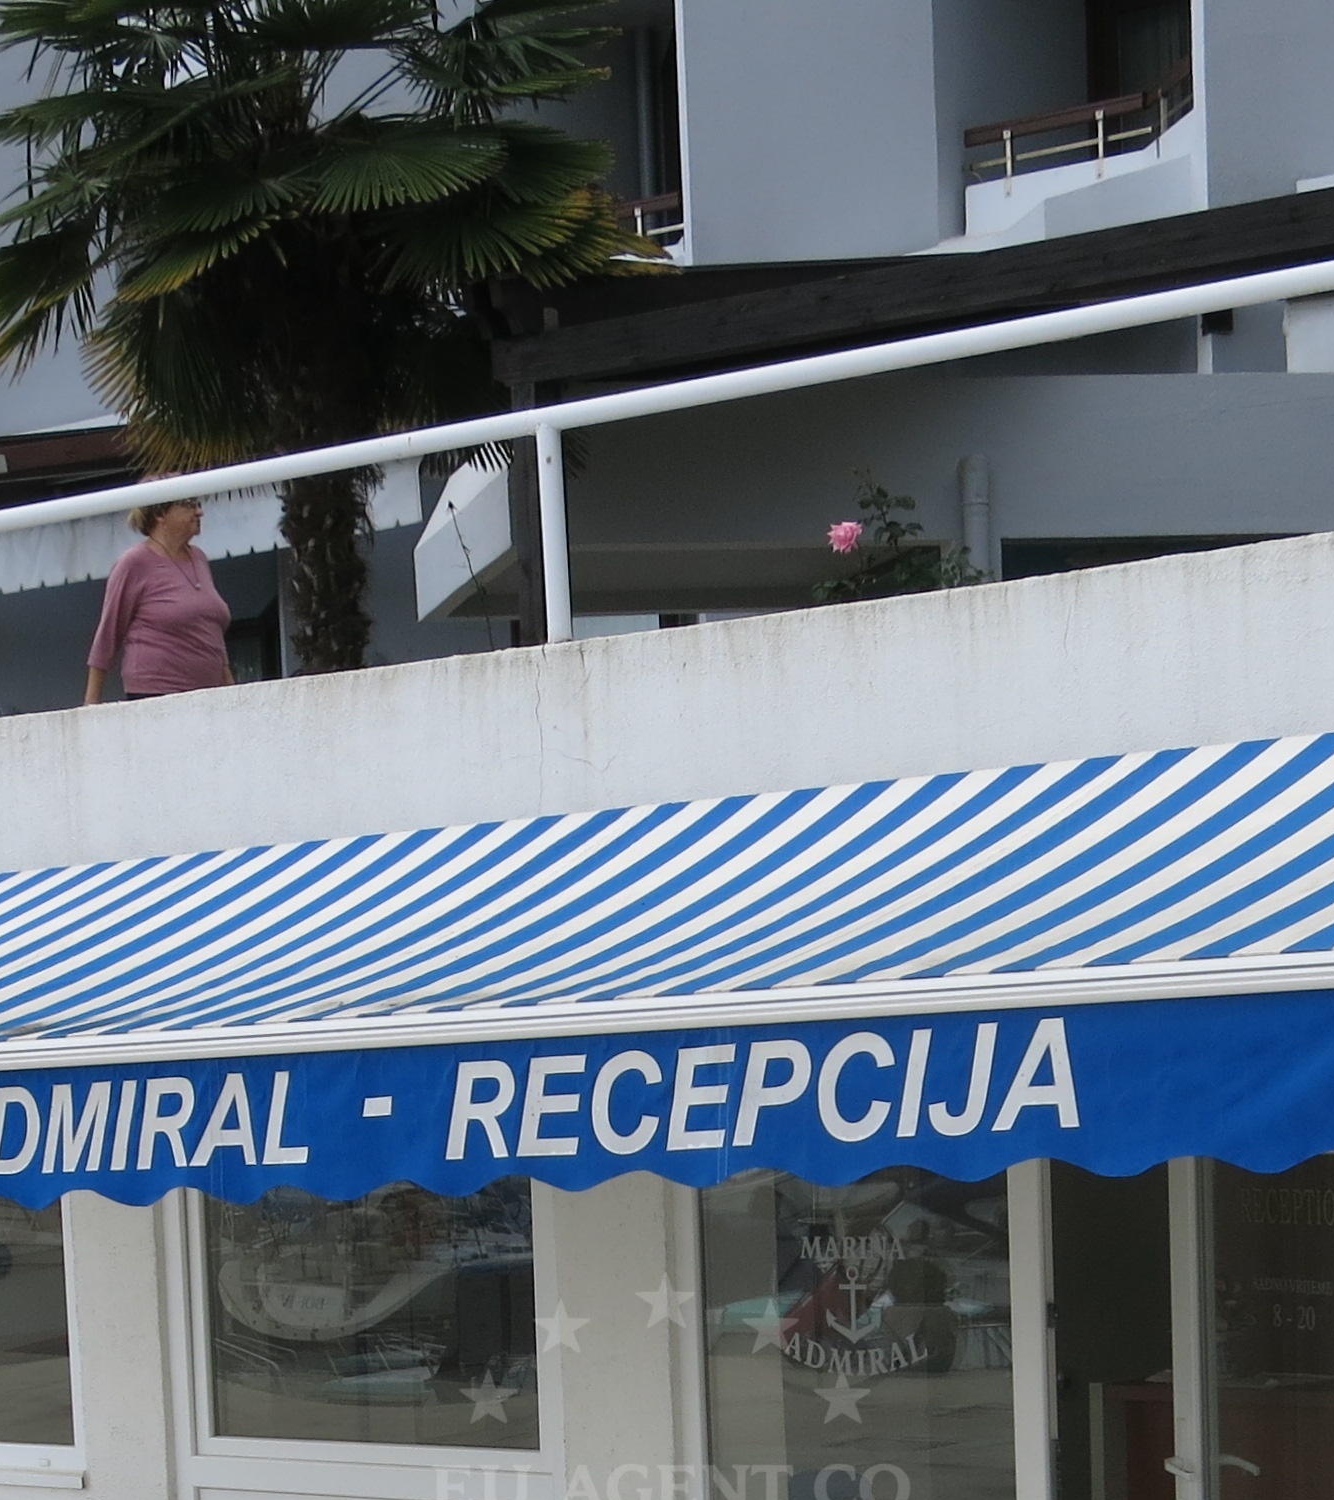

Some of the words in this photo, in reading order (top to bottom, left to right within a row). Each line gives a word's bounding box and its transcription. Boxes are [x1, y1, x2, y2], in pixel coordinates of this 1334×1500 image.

[361, 1096, 393, 1118] -
[445, 1016, 1081, 1161] RECEPCIJA
[799, 1236, 907, 1261] MARINA
[1273, 1303, 1283, 1328] 8
[1297, 1305, 1317, 1331] 20
[784, 1331, 929, 1377] ADMIRAL
